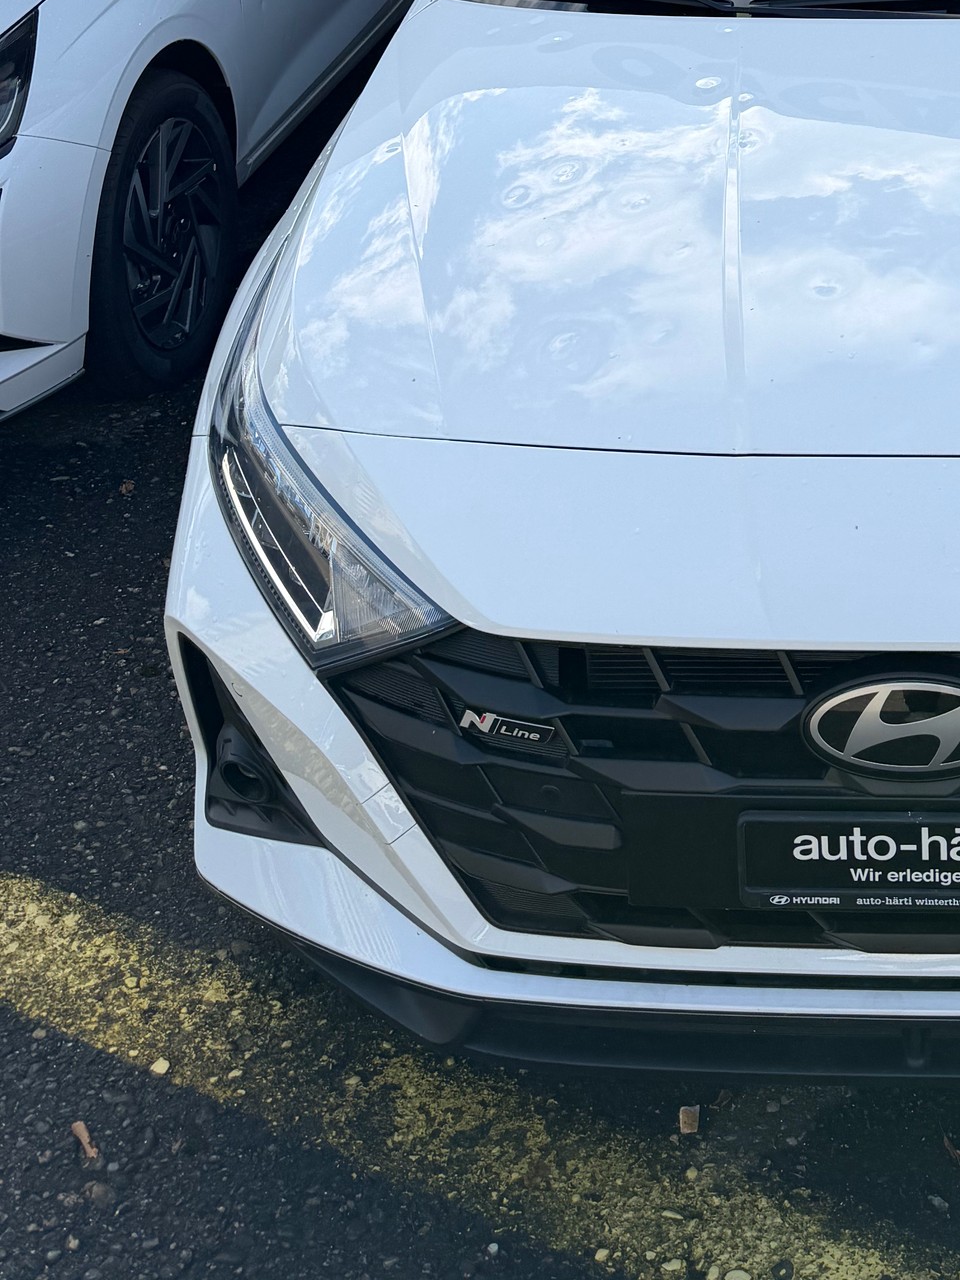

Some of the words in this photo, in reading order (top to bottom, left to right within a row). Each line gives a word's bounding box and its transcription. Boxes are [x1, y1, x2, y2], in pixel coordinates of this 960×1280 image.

[500, 725, 541, 741] Line
[849, 867, 882, 883] Wir
[792, 896, 841, 905] HYUNDAI
[855, 896, 913, 907] auto-härti
